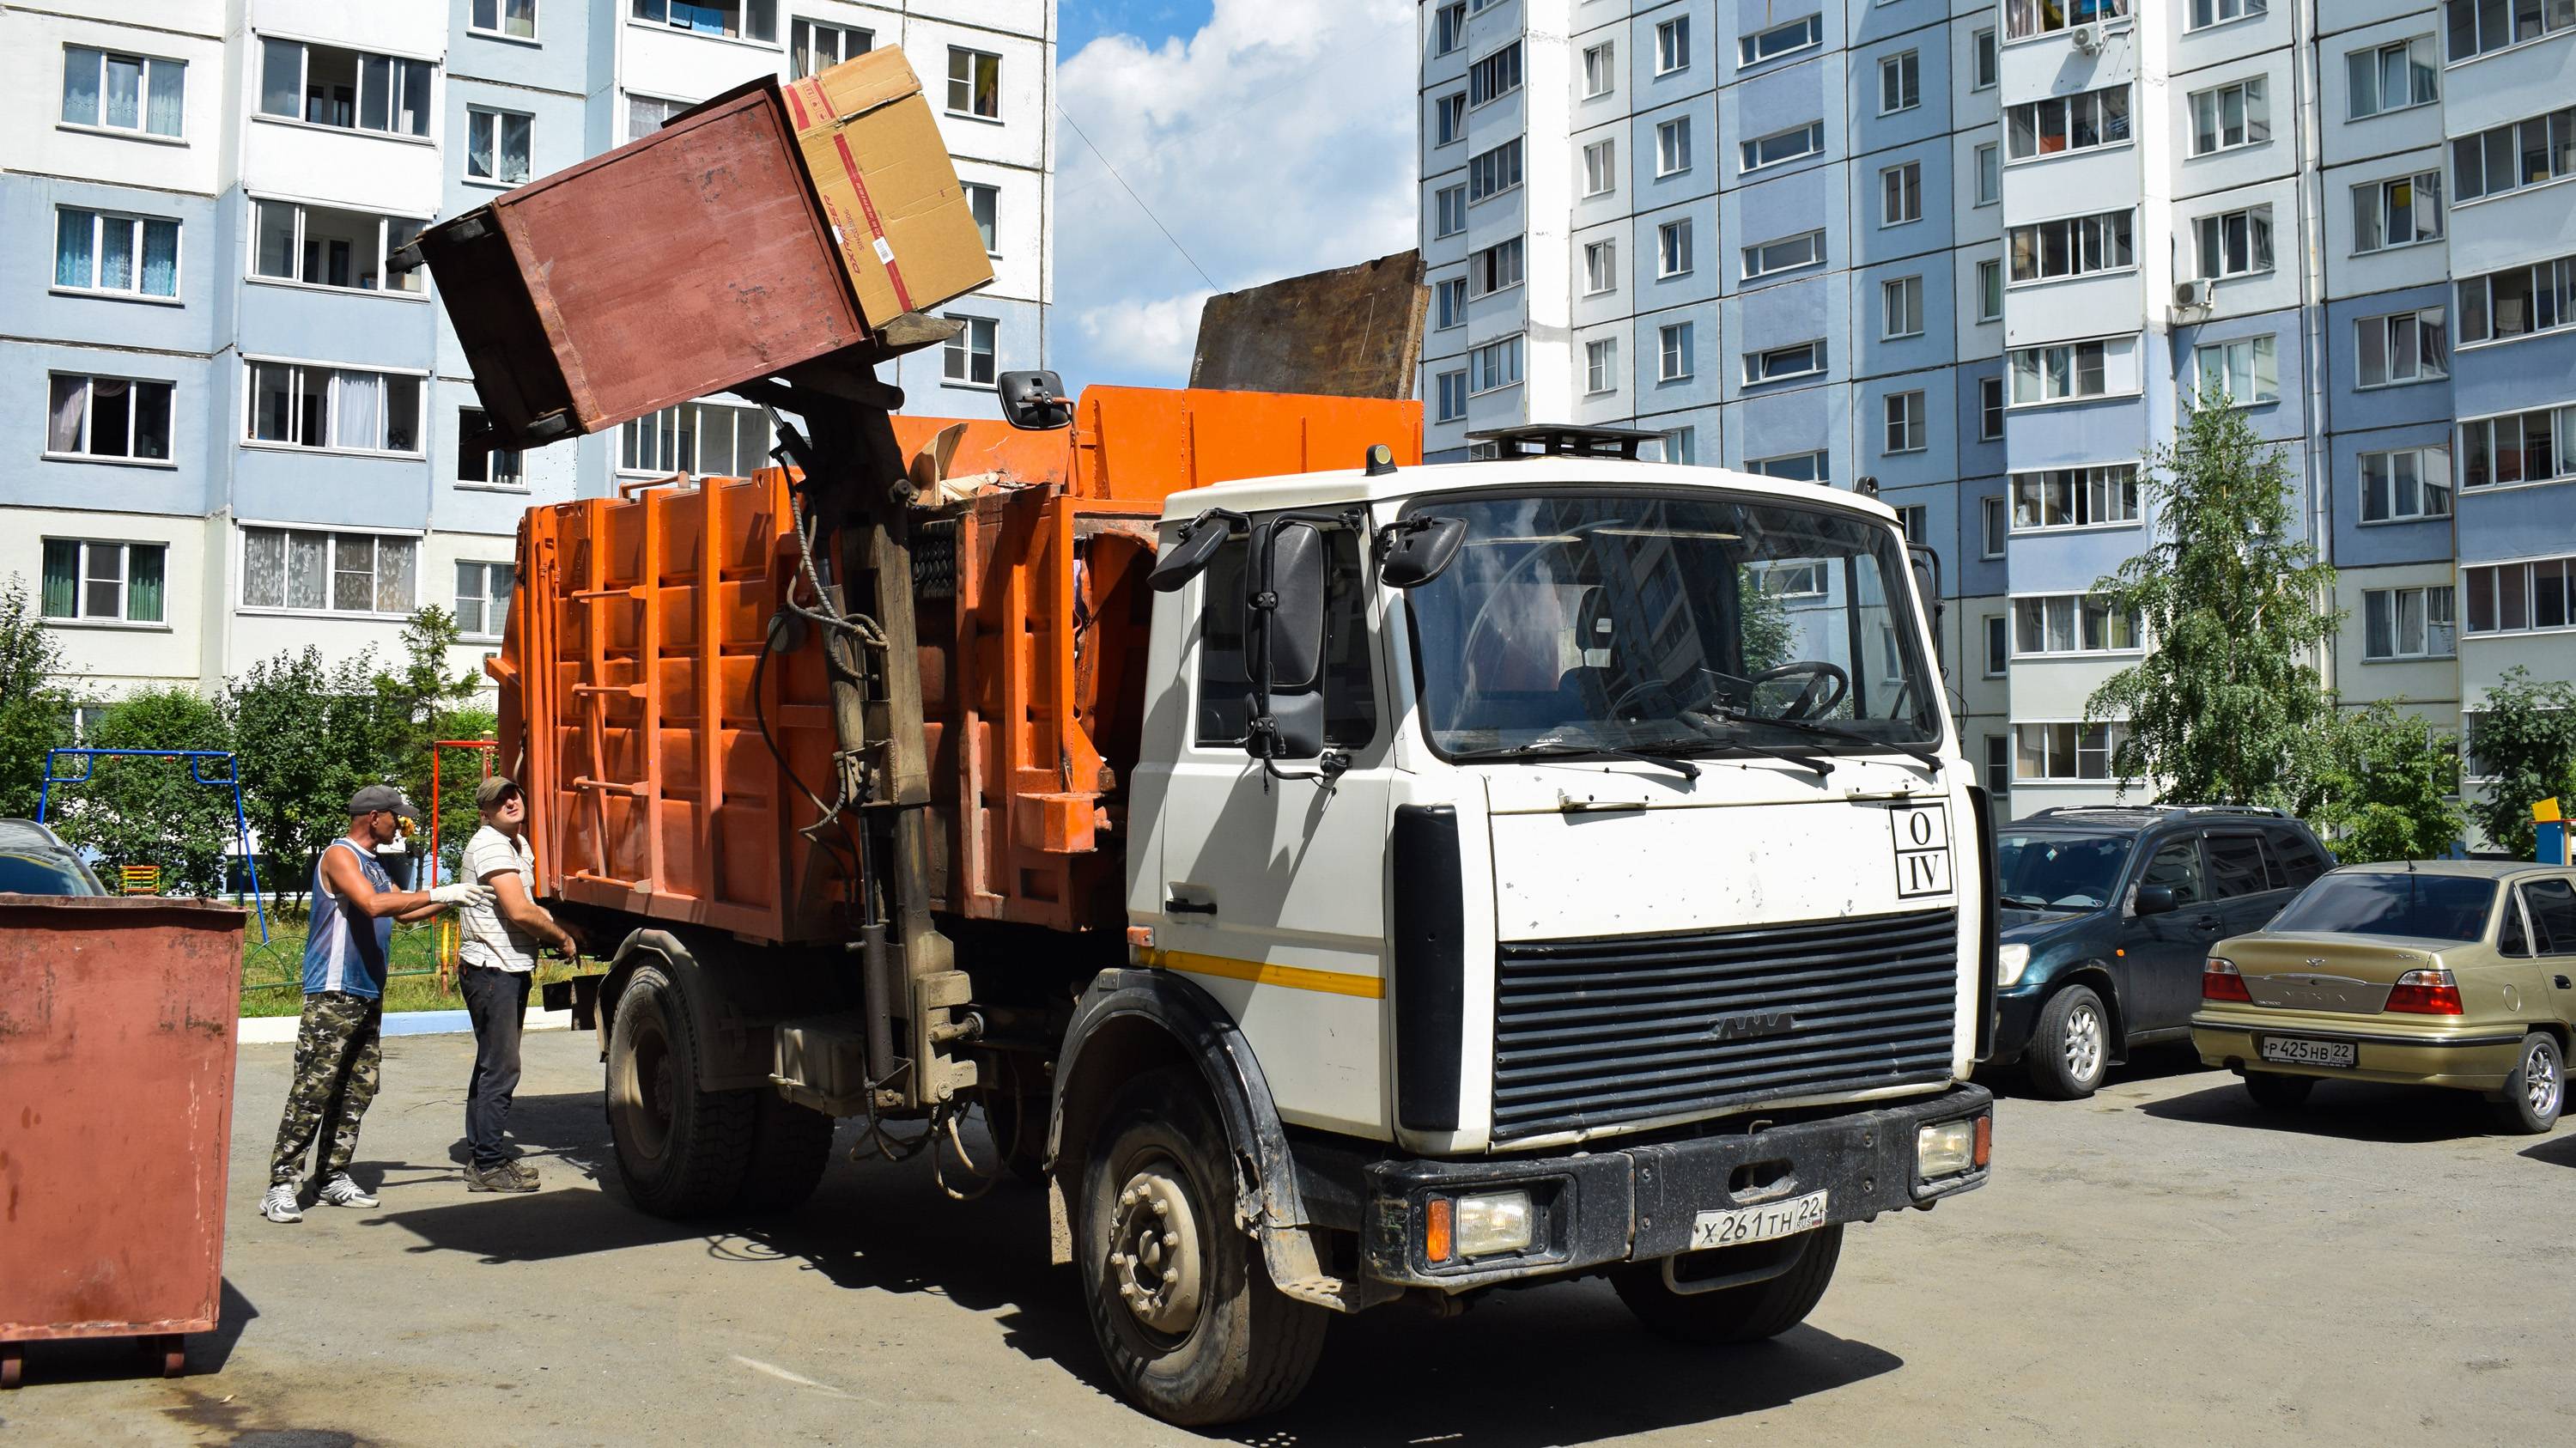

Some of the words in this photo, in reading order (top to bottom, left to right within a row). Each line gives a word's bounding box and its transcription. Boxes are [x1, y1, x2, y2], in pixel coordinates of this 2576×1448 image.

[856, 182, 874, 219] SERIES
[824, 193, 860, 274] DXRACER
[1907, 855, 1939, 891] IV
[2333, 1044, 2349, 1058] 22
[1800, 1196, 1820, 1220] 22
[1796, 1220, 1812, 1229] RUS
